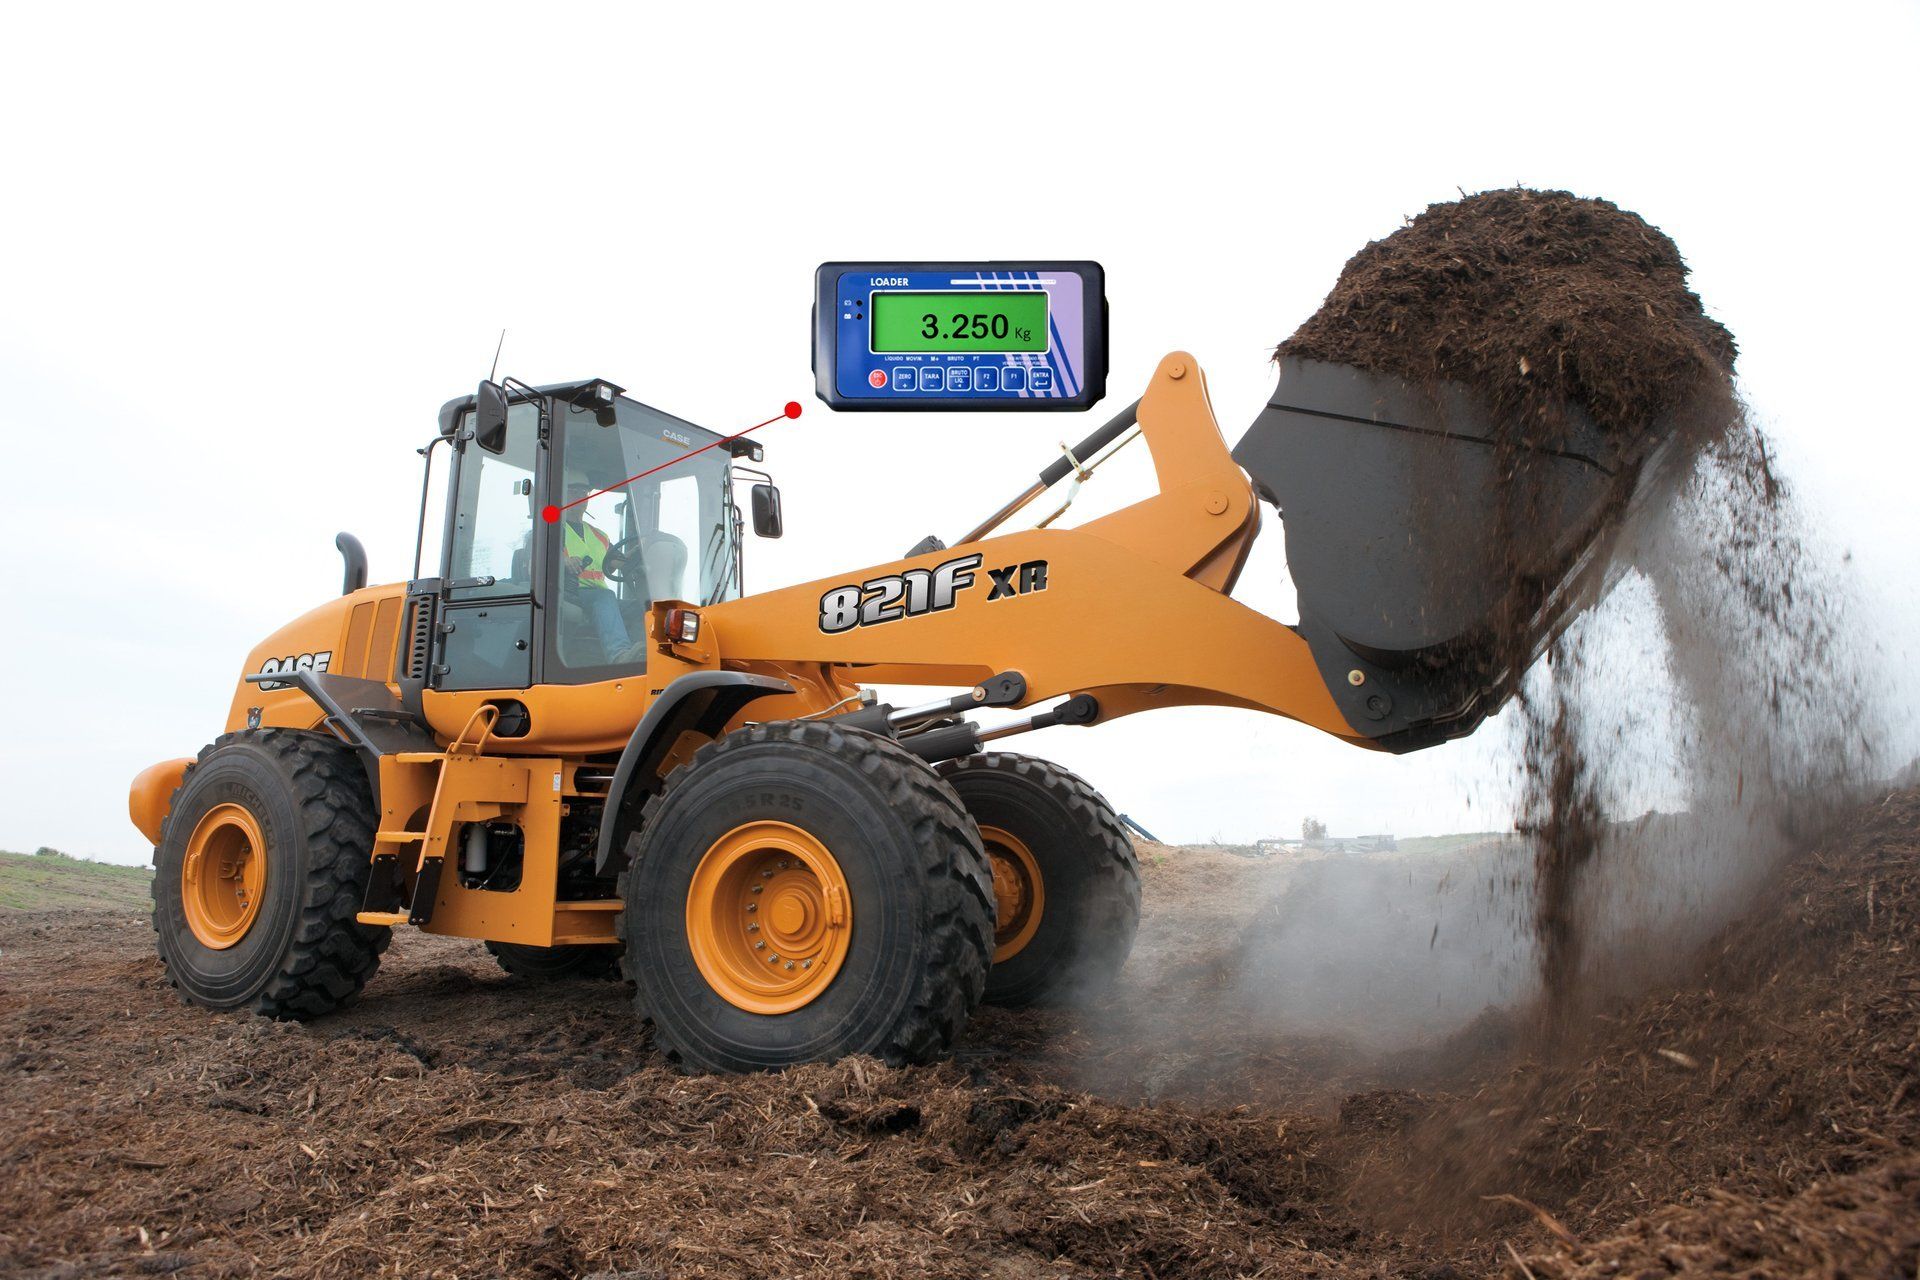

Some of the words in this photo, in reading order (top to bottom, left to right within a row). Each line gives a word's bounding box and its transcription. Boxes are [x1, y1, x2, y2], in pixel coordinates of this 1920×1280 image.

[870, 277, 909, 287] LOADER
[921, 313, 1009, 340] 3.250
[1014, 327, 1032, 342] Kg
[1032, 371, 1050, 379] ENTRA
[663, 429, 691, 445] CASE
[818, 552, 984, 635] 821F
[986, 559, 1049, 602] XR
